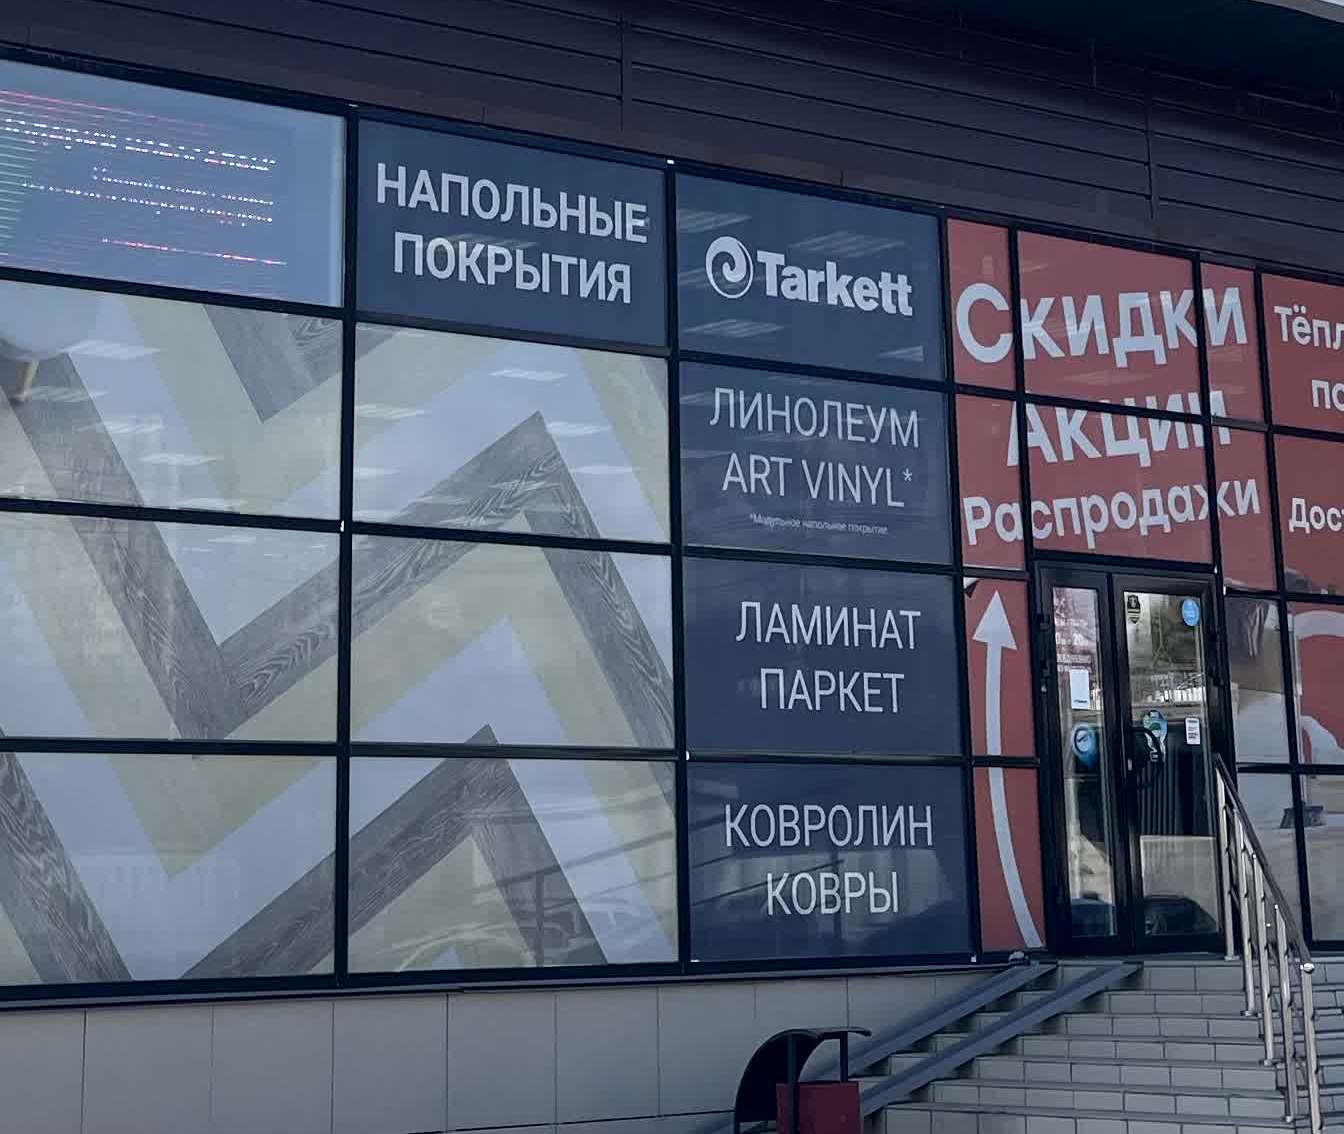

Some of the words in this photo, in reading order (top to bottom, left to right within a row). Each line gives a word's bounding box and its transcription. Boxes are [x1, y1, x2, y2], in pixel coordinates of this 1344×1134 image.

[376, 162, 649, 244] НАПОЛЬНЫЕ
[394, 231, 633, 305] ПОКРЫТИЯ
[757, 250, 914, 317] Tarkett
[955, 282, 1249, 369] Скидки
[709, 387, 920, 449] ЛИНОЛЕУМ
[1006, 389, 1232, 467] Акции
[722, 452, 793, 494] ART
[962, 477, 1262, 550] Распродажи
[736, 601, 922, 650] ЛАМИНАТ
[759, 667, 905, 714] ПАРКЕТ
[724, 803, 934, 848] КОВРОЛИН
[766, 870, 899, 916] КОВРЫ
